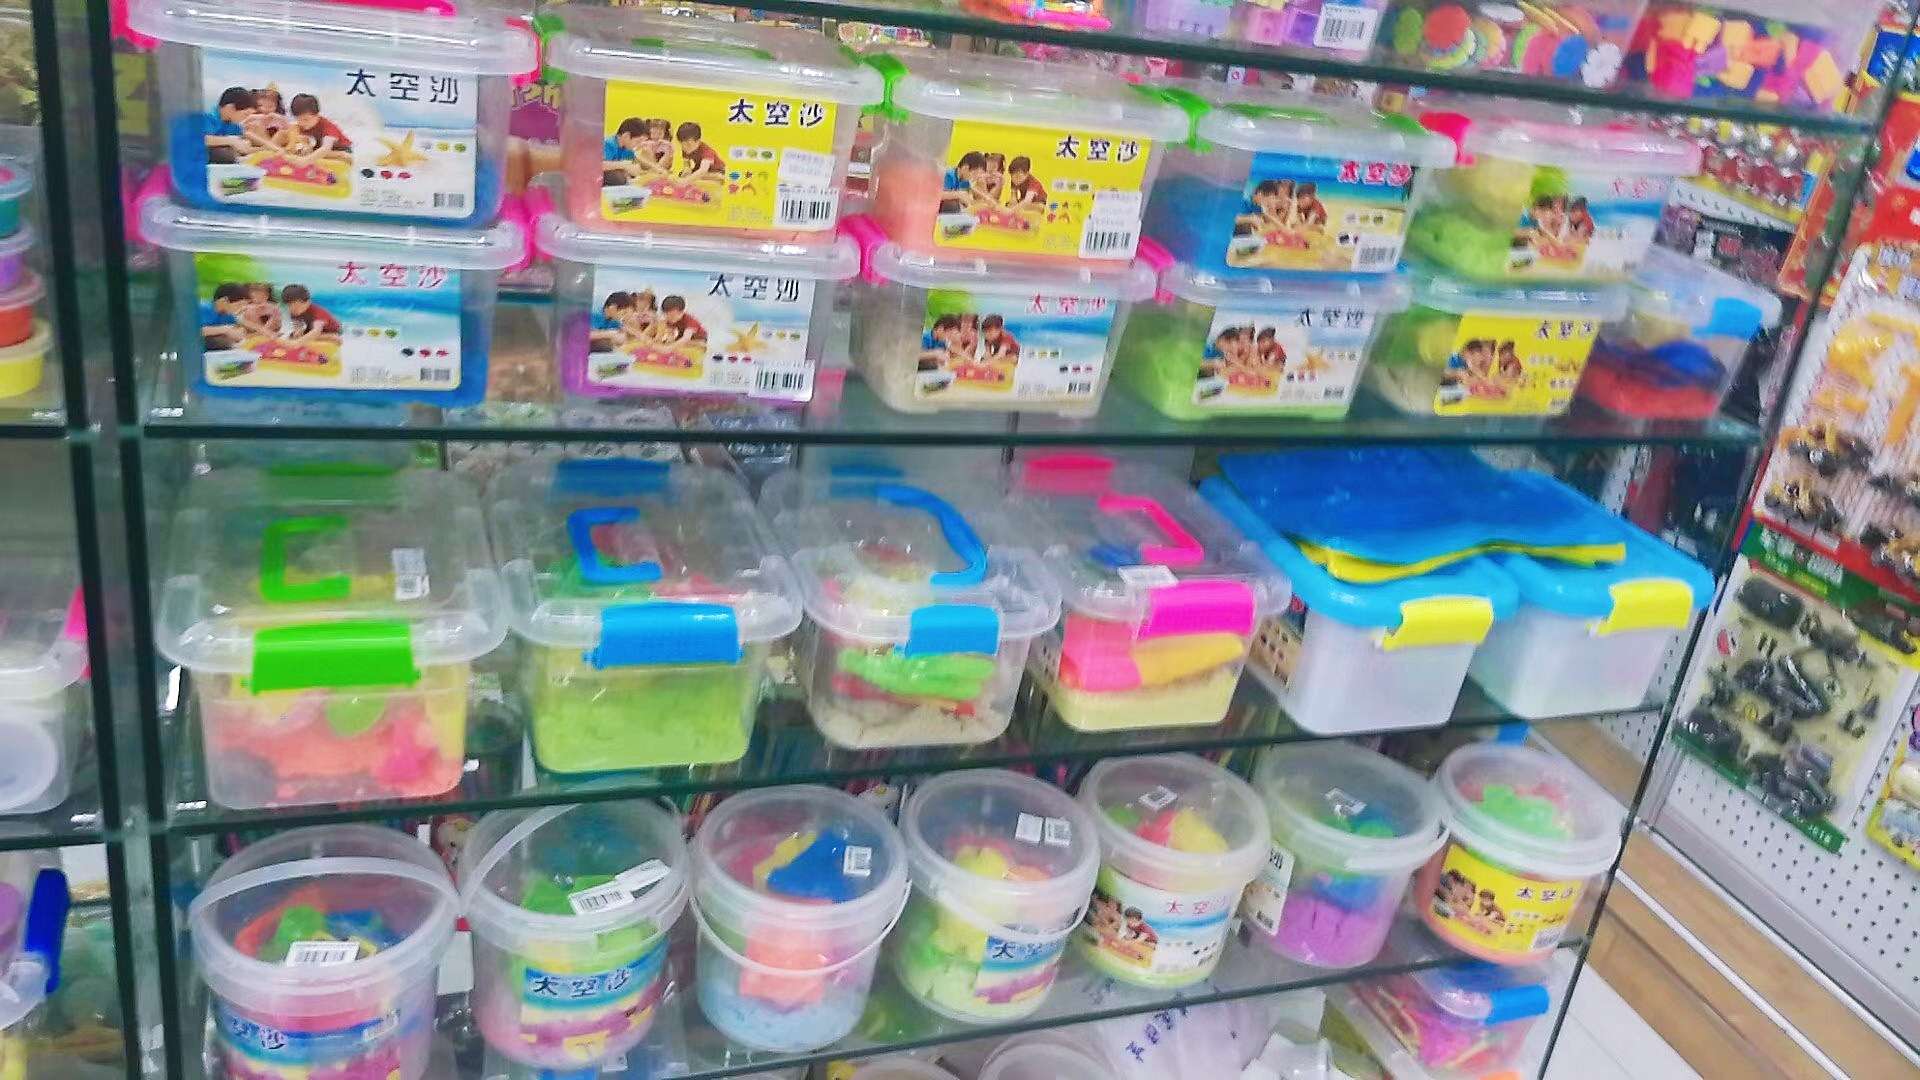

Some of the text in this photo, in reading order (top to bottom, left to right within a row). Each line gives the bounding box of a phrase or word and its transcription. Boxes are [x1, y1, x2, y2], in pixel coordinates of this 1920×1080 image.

[346, 68, 460, 105] 太空沙
[728, 97, 826, 129] 太空沙
[1054, 134, 1141, 164] 太空沙
[1339, 160, 1414, 186] 太空沙
[336, 261, 450, 290] 太空沙
[708, 273, 800, 302] 太空沙
[533, 968, 630, 999] 太空沙
